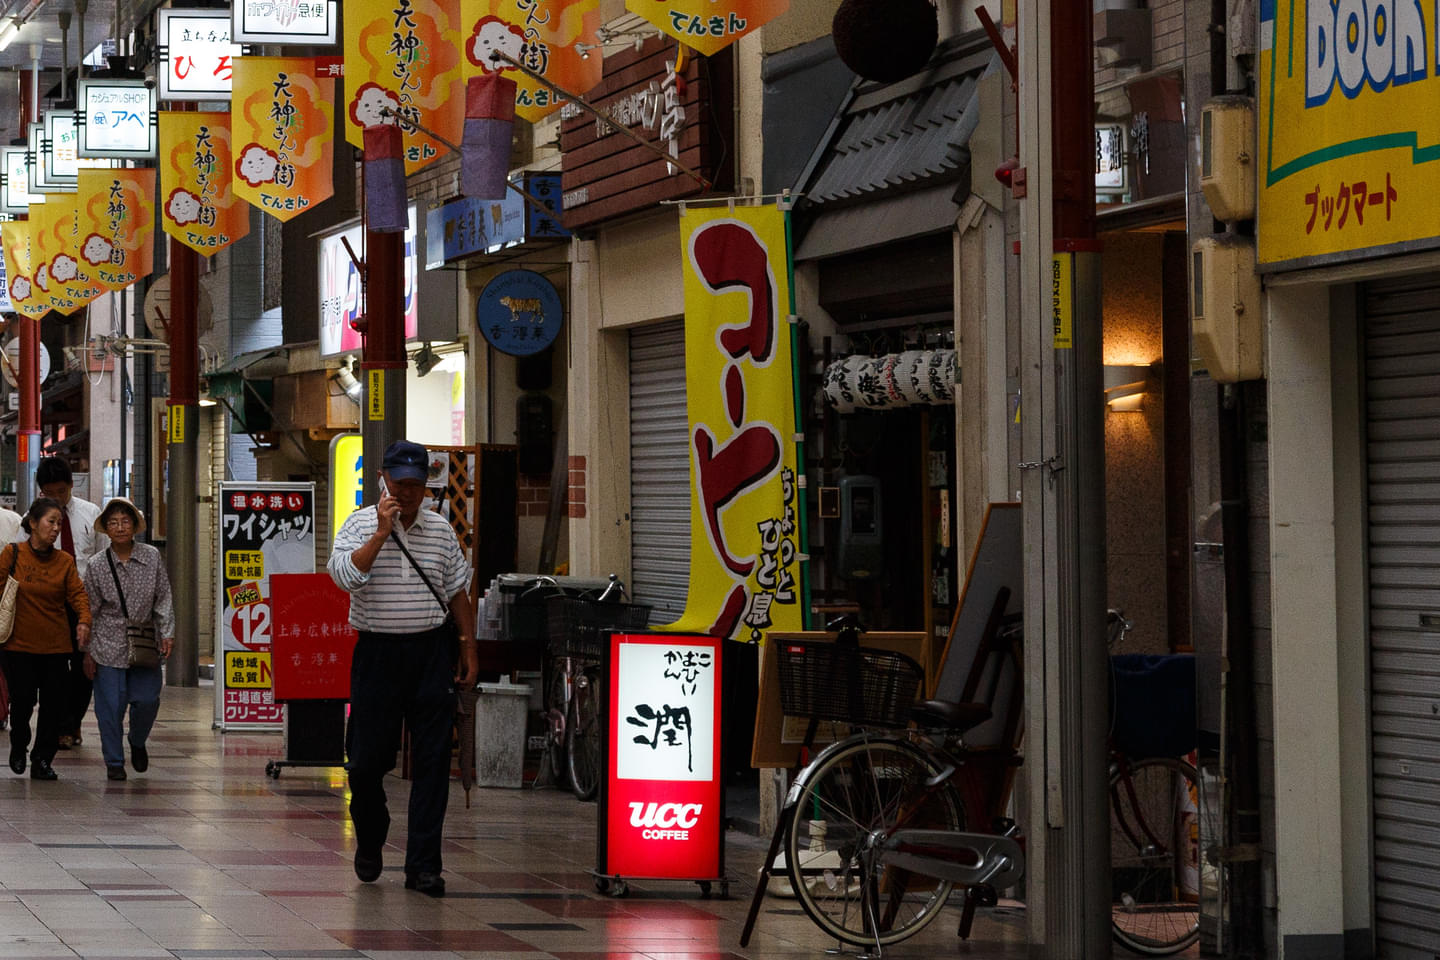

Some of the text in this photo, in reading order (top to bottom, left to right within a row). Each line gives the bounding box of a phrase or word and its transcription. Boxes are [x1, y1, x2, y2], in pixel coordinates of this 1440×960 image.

[247, 2, 325, 18] ホワイト急便
[669, 9, 747, 37] てんさん
[266, 72, 297, 188] 天神さんの街
[260, 192, 309, 209] てんさん
[1305, 172, 1398, 235] ブックマート
[186, 231, 230, 247] てんさん
[98, 270, 137, 284] てんさん
[688, 218, 785, 639] コーヒー
[232, 494, 303, 509] 温水洗い
[223, 513, 312, 541] ワイシャツ
[774, 465, 797, 605] ちょっと
[228, 552, 261, 564] 無料で
[231, 671, 259, 684] 品質
[628, 801, 703, 829] UCC
[642, 829, 689, 841] COFFEE
